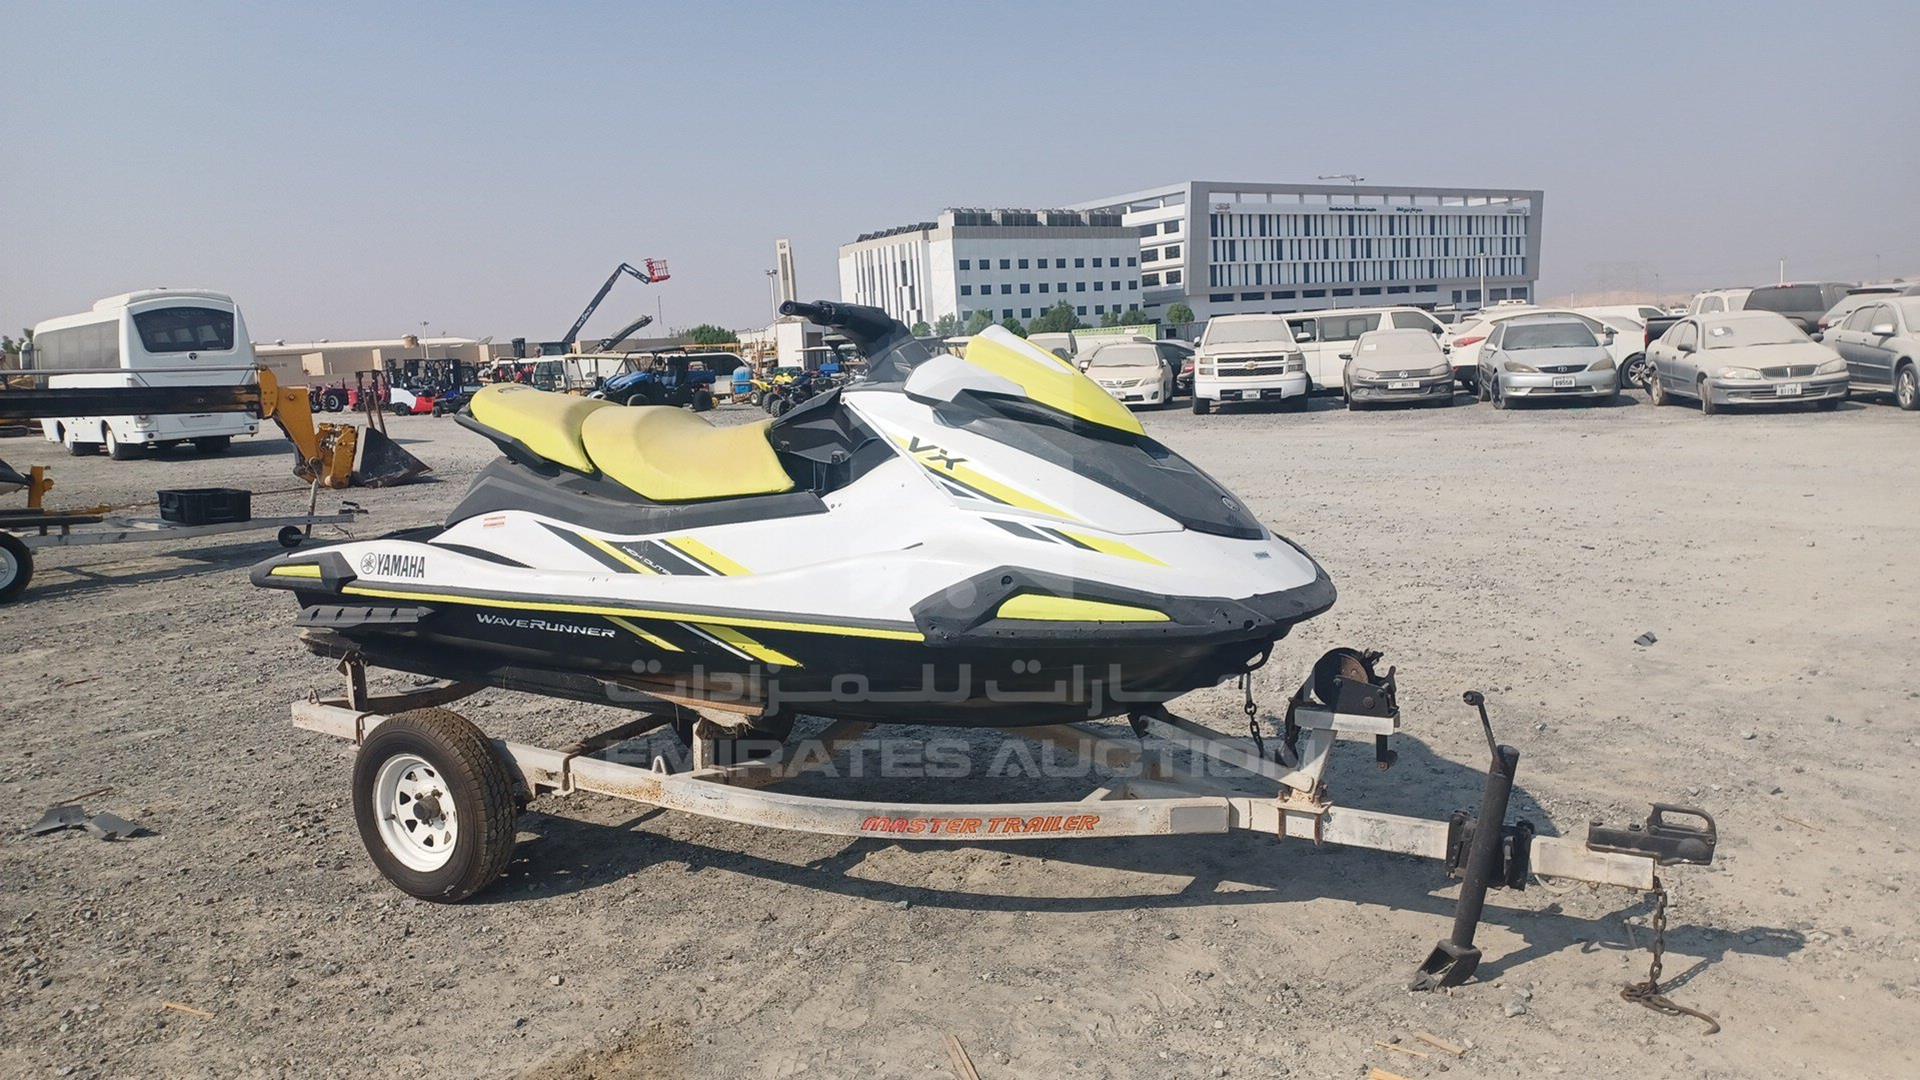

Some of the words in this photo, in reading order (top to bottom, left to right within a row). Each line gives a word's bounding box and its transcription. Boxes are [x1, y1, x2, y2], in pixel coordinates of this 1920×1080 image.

[908, 435, 968, 471] VX
[376, 553, 425, 579] YAMAHA
[860, 815, 983, 834] MASTER
[988, 815, 1100, 833] TRAILER
